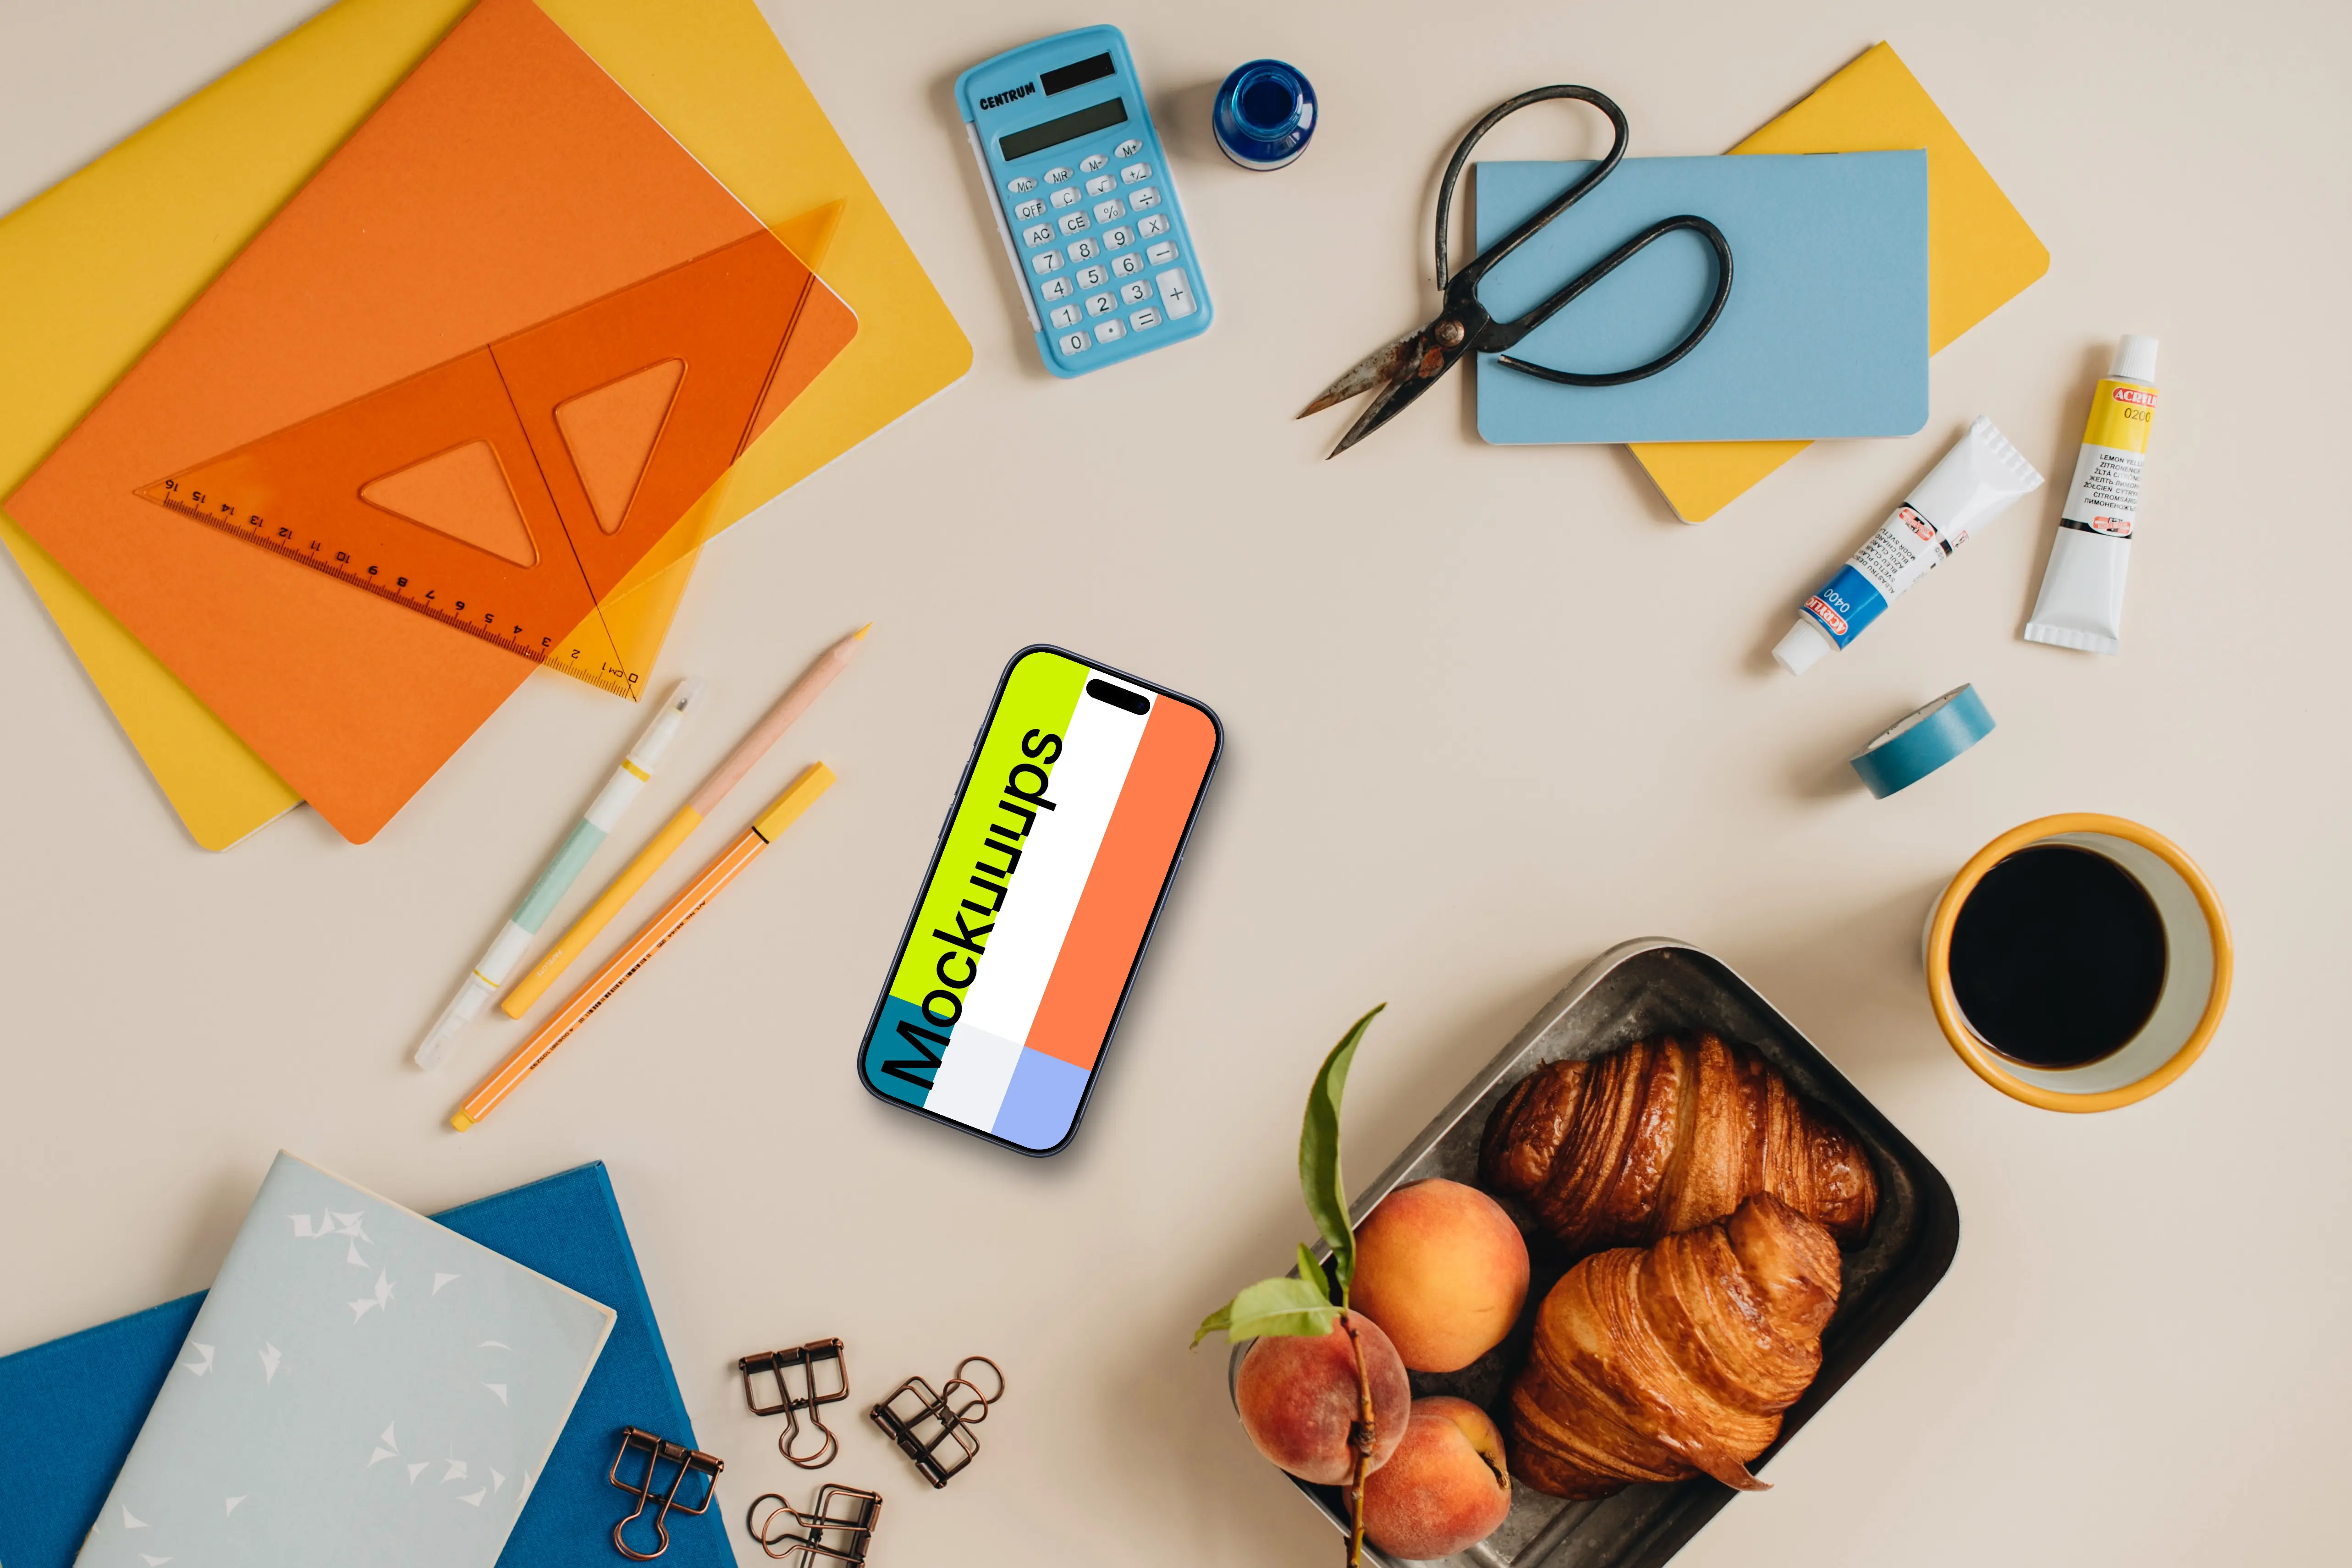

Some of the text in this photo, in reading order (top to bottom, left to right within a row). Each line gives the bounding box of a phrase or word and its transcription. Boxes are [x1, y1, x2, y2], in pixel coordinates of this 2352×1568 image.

[980, 82, 1036, 110] CENTRUM
[1017, 181, 1032, 193] MC
[1053, 171, 1068, 182] MR
[1022, 203, 1042, 217] OFF
[1033, 228, 1050, 242] AC
[1068, 216, 1085, 231] CE
[1044, 254, 1053, 269] 7
[1080, 244, 1090, 257] 8
[1114, 232, 1125, 245] 9
[1054, 281, 1064, 295] 4
[1088, 270, 1099, 283] 5
[1123, 258, 1134, 272] 6
[1063, 309, 1071, 322] 1
[1097, 297, 1109, 312] 2
[1132, 286, 1143, 299] 3
[1071, 336, 1081, 349] 0
[2115, 390, 2157, 406] ACRYLI
[2125, 408, 2150, 422] 0200
[2100, 454, 2124, 463] LEMON
[1875, 534, 1908, 564] BLU CHIARO
[1873, 561, 1895, 583] SVETLO
[1881, 558, 1897, 573] BLEU
[1890, 555, 1904, 569] AZUL
[165, 479, 639, 683] 0 CM 1 2 3 4 5 6 7 8 9 10 11 12 13 14 15 16
[1824, 589, 1850, 612] 0400
[1806, 598, 1845, 632] ACRYLIC
[881, 728, 1063, 1091] Mockuuups
